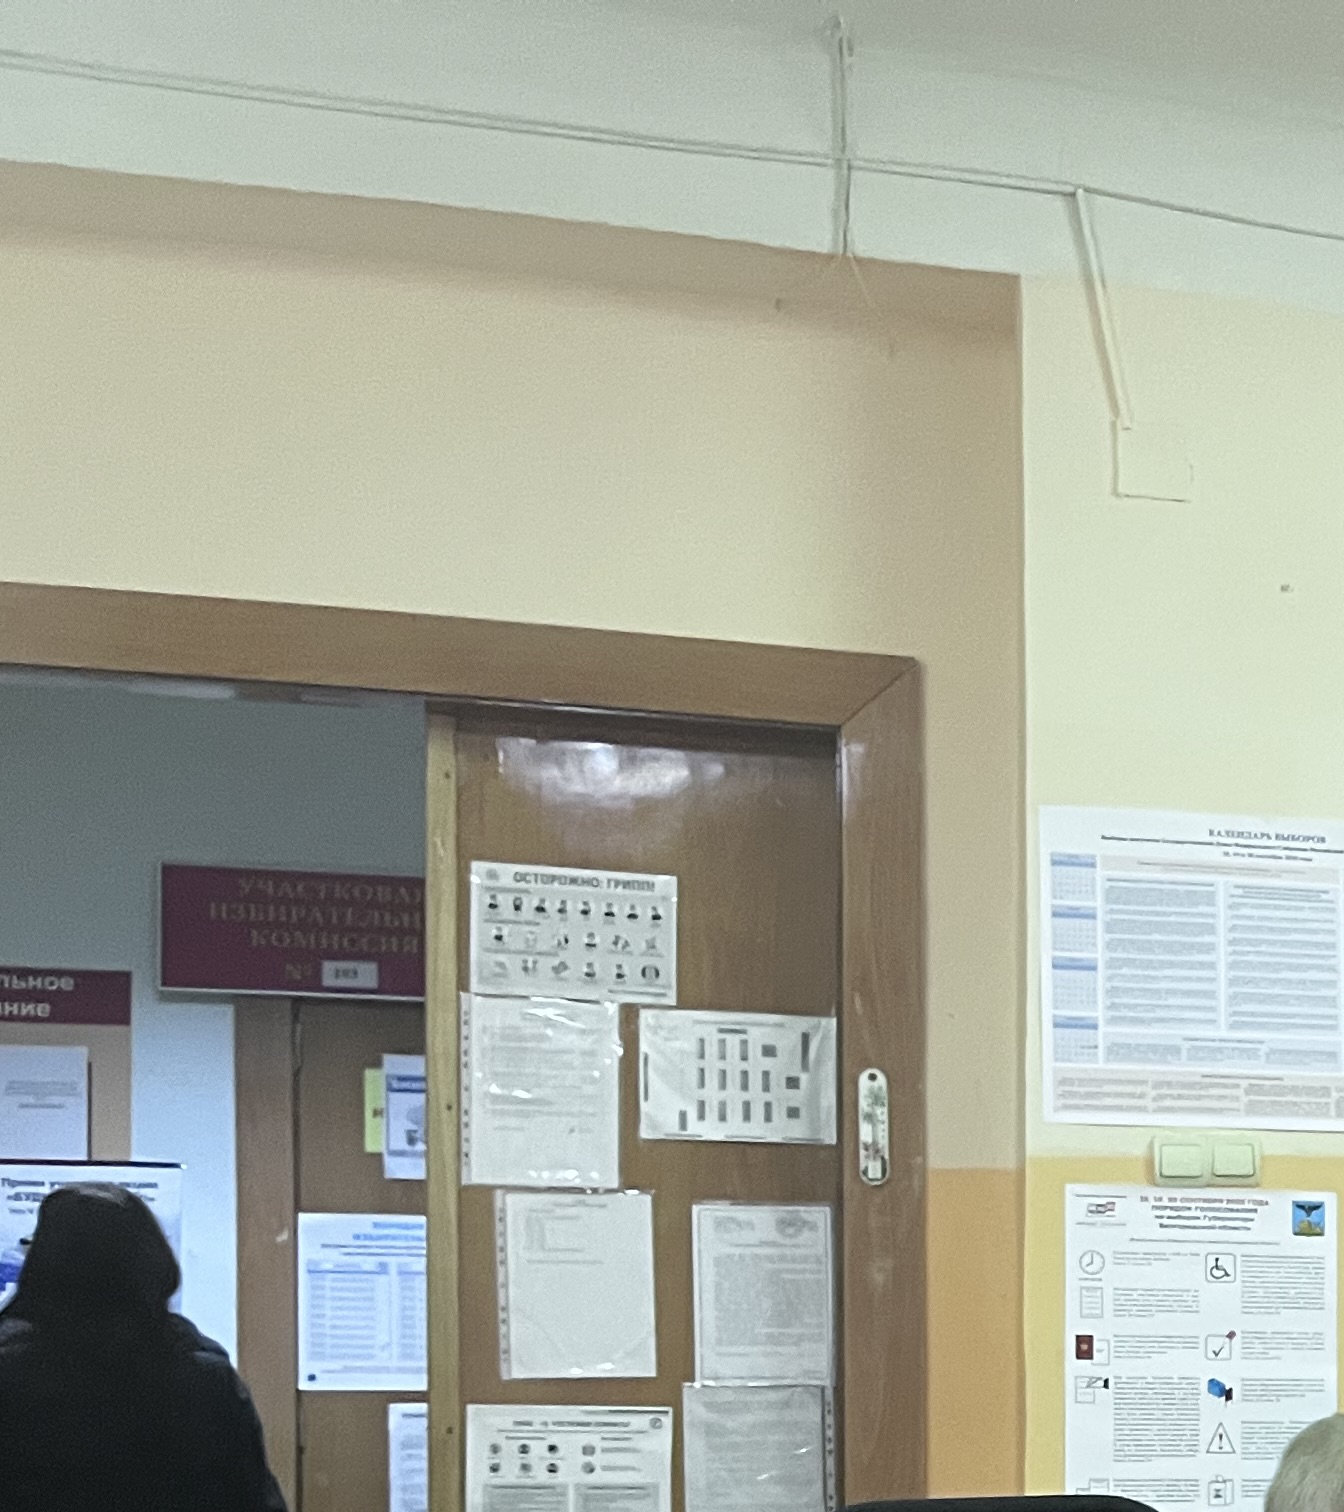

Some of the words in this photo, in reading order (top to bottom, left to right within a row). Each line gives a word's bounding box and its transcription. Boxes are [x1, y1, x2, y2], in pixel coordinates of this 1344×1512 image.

[238, 875, 425, 904] УЧАСТКОВА
[513, 871, 603, 888] ОСТОРОЖНО:
[209, 901, 423, 929] ИЗБИРАТЕЛЬН
[250, 928, 419, 954] КОМИССИЯ
[0, 1001, 50, 1018] ние
